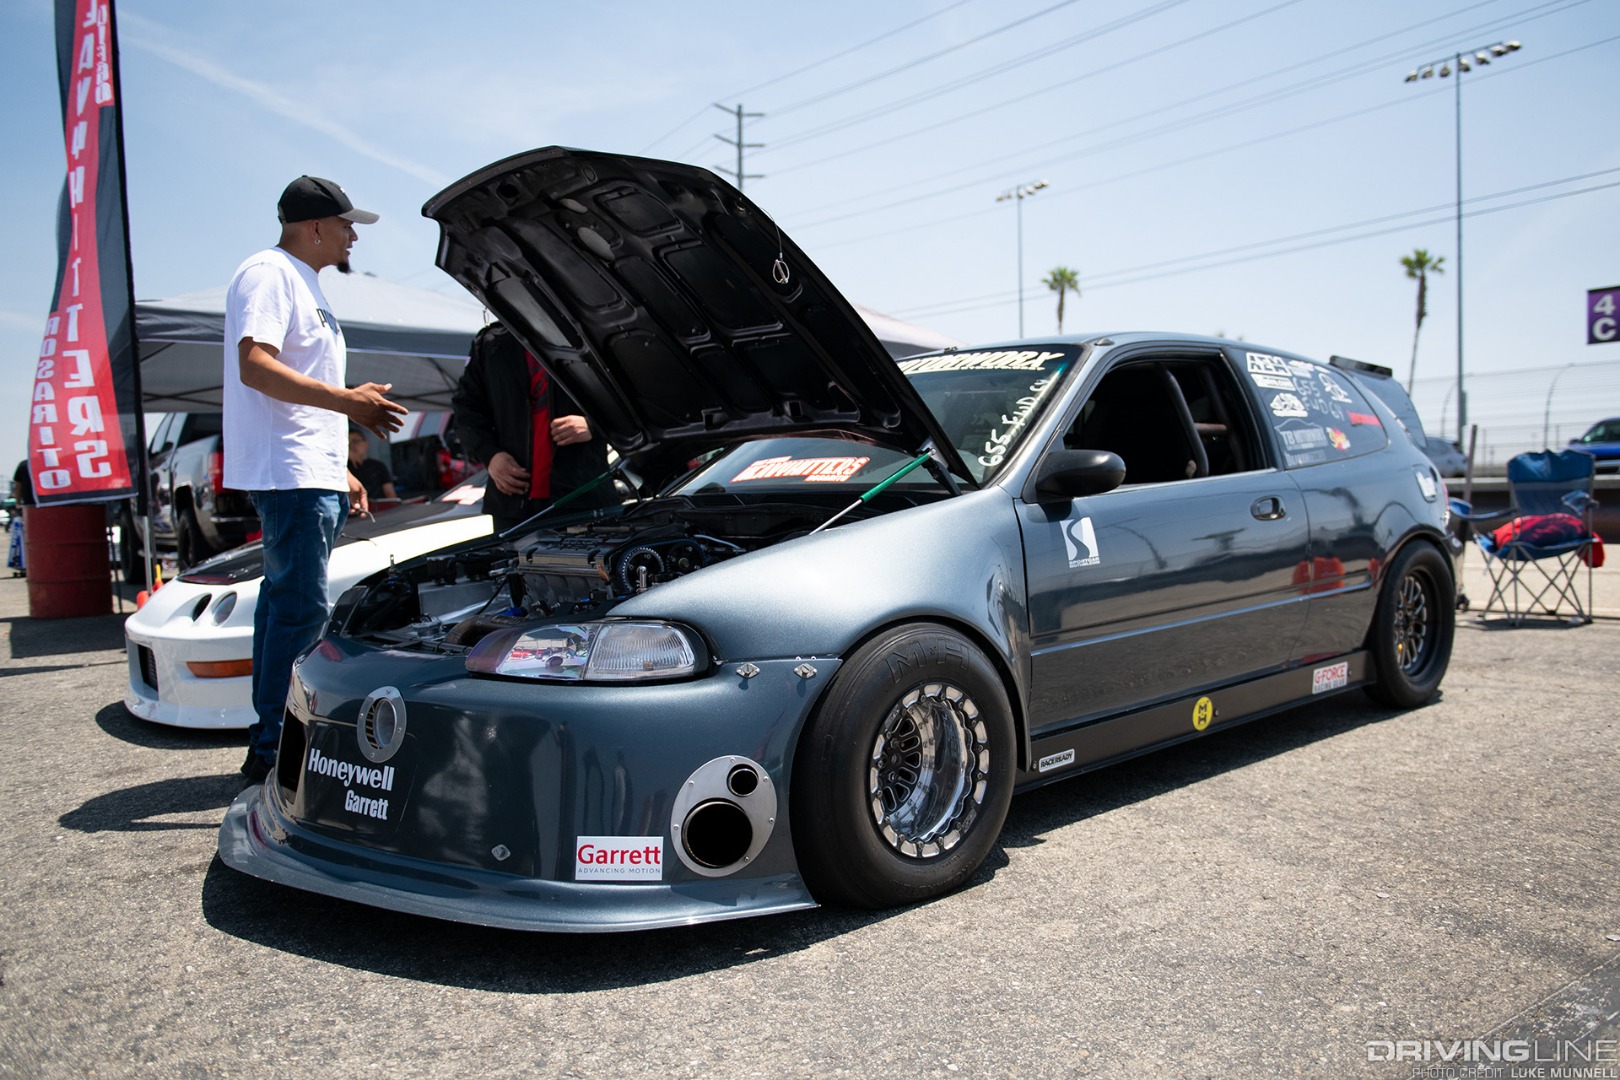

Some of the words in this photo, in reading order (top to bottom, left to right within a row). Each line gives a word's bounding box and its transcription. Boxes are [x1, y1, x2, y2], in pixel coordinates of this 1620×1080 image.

[977, 428, 1012, 467] 655
[308, 748, 395, 791] Honeywell
[344, 790, 389, 820] Garrett
[577, 844, 661, 865] Garrett
